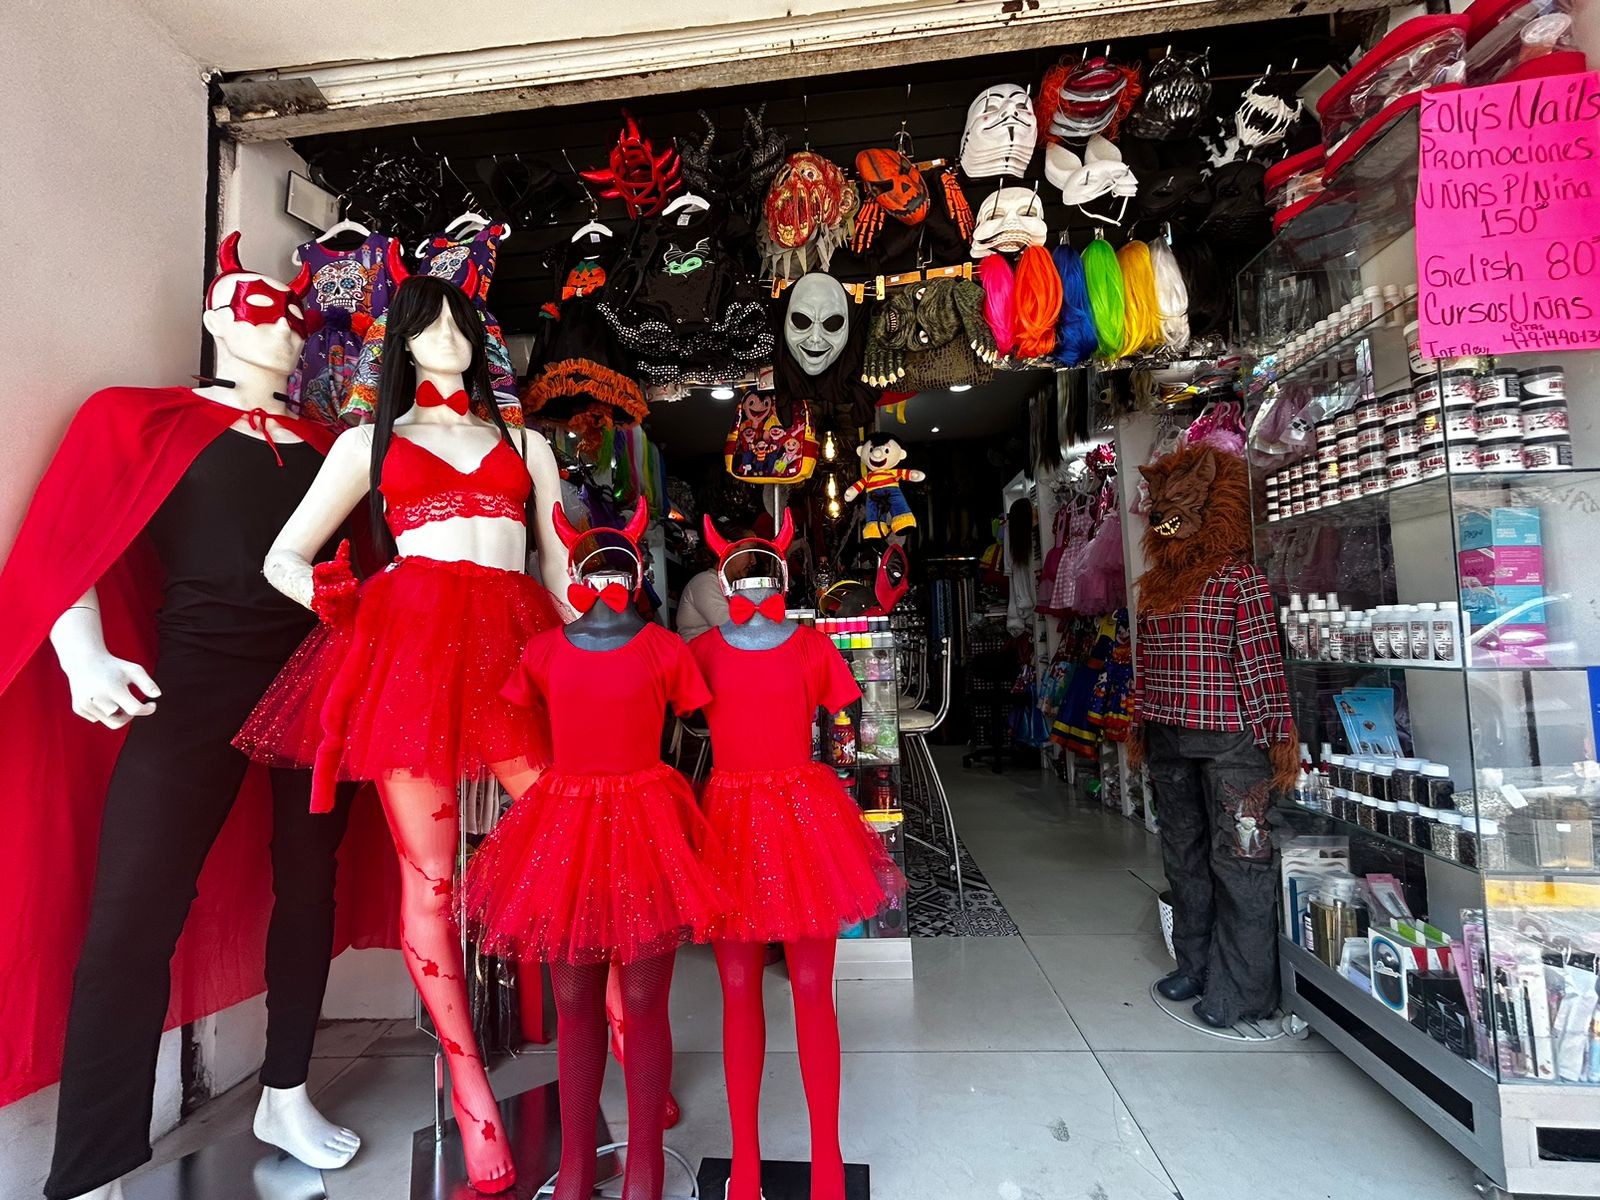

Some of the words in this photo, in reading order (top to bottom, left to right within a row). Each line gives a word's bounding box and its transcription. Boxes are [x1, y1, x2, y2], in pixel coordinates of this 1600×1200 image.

[1509, 79, 1600, 131] Nails
[1420, 179, 1498, 209] UÑAS
[1425, 251, 1523, 288] Gelish
[1425, 292, 1508, 326] Cursos
[1510, 291, 1593, 324] UÑAS
